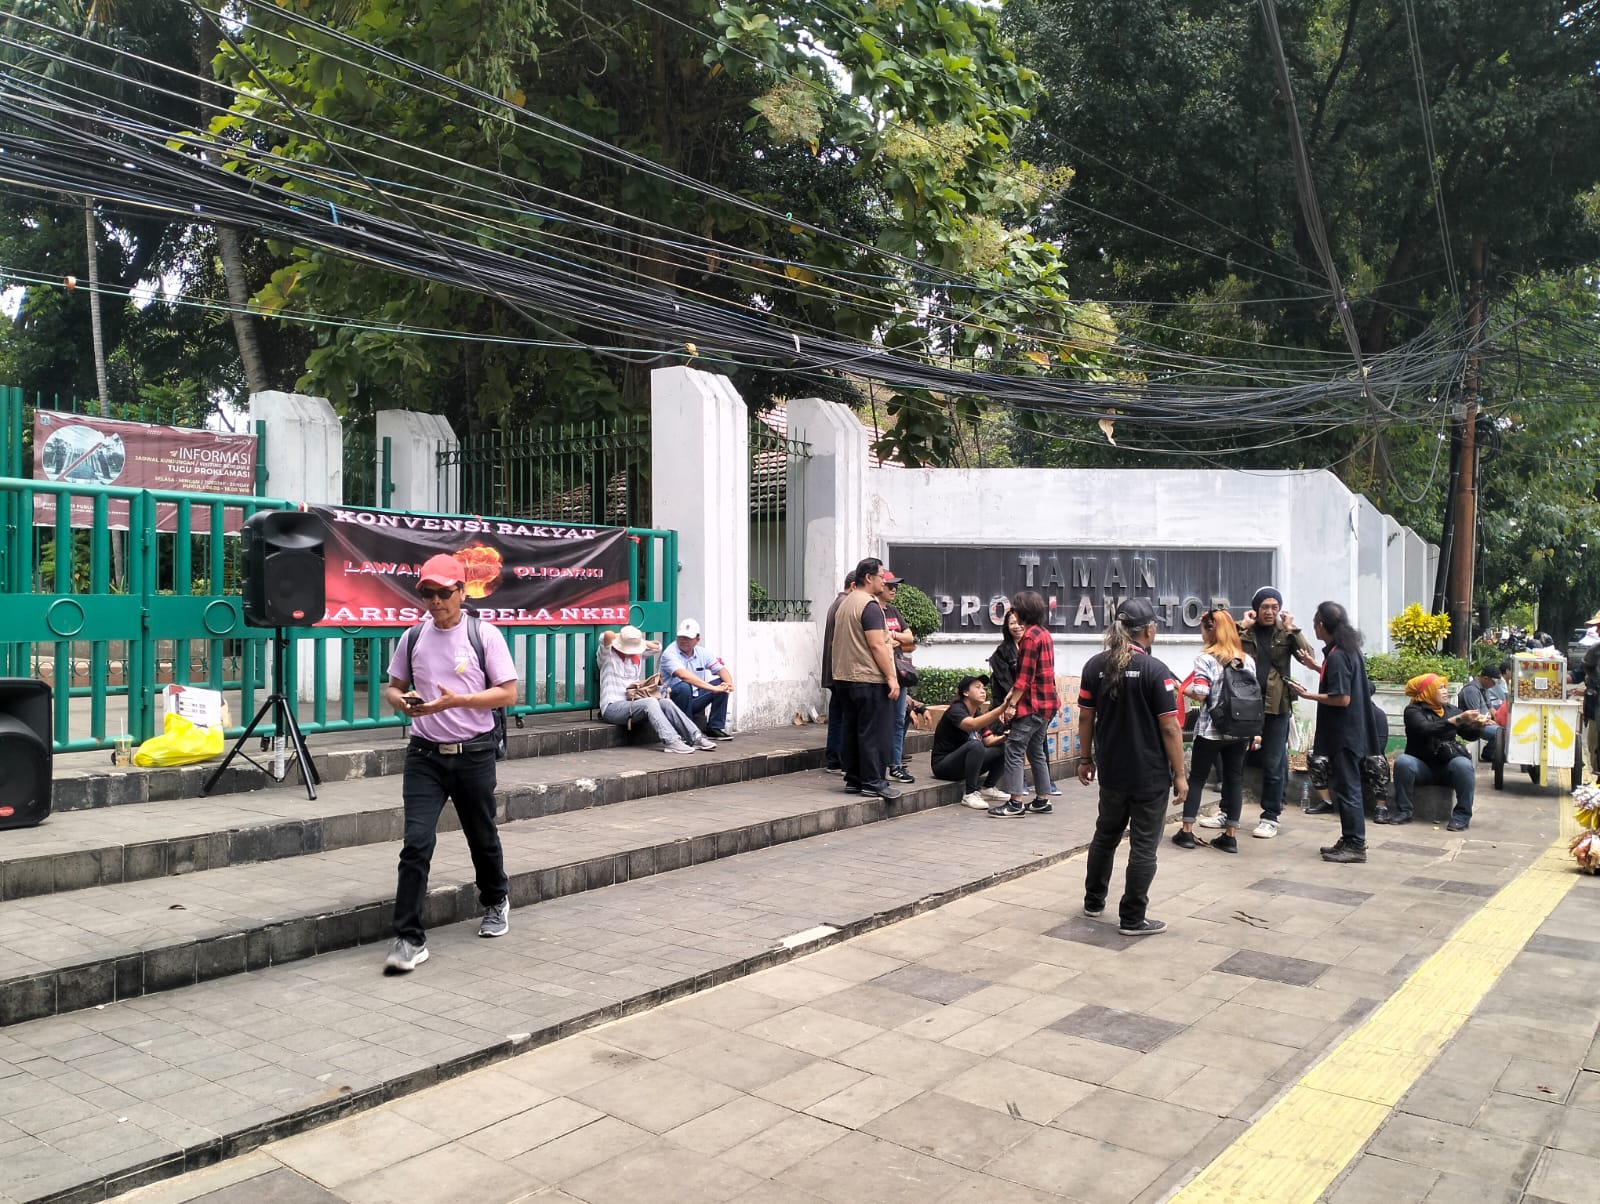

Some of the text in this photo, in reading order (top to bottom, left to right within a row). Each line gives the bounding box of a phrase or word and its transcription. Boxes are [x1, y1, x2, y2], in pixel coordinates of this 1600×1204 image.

[179, 447, 251, 465] INFORMASI
[168, 464, 250, 478] TUGU PROKLAMASI
[333, 509, 597, 540] KONVENSI RAKYAT
[513, 565, 604, 580] OLIGARKI
[1018, 556, 1158, 588] TAMAN
[476, 608, 553, 622] BELA
[560, 607, 626, 621] NKRI
